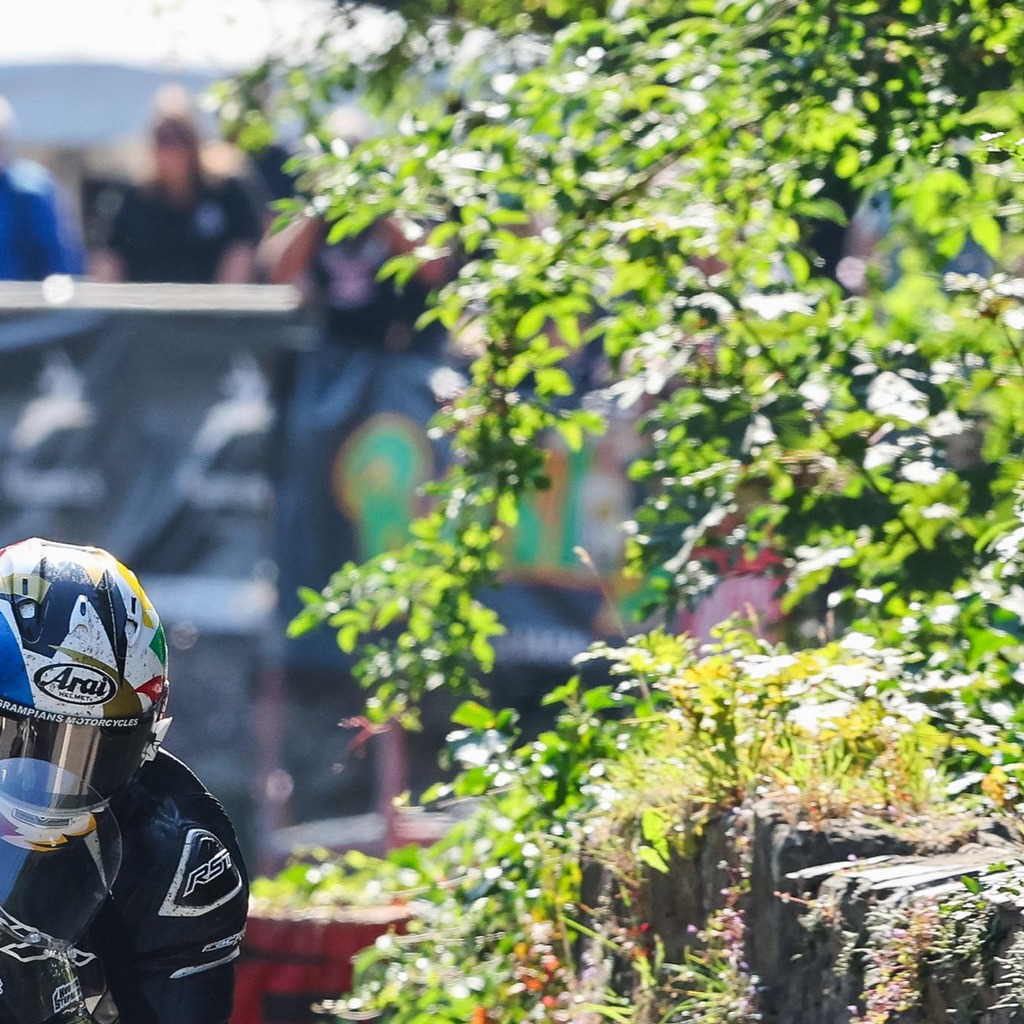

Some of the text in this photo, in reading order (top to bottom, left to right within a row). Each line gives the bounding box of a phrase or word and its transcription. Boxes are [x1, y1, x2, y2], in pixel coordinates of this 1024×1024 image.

[37, 667, 109, 697] Arai
[65, 716, 139, 727] MOTORCYCLES
[183, 849, 232, 898] RST
